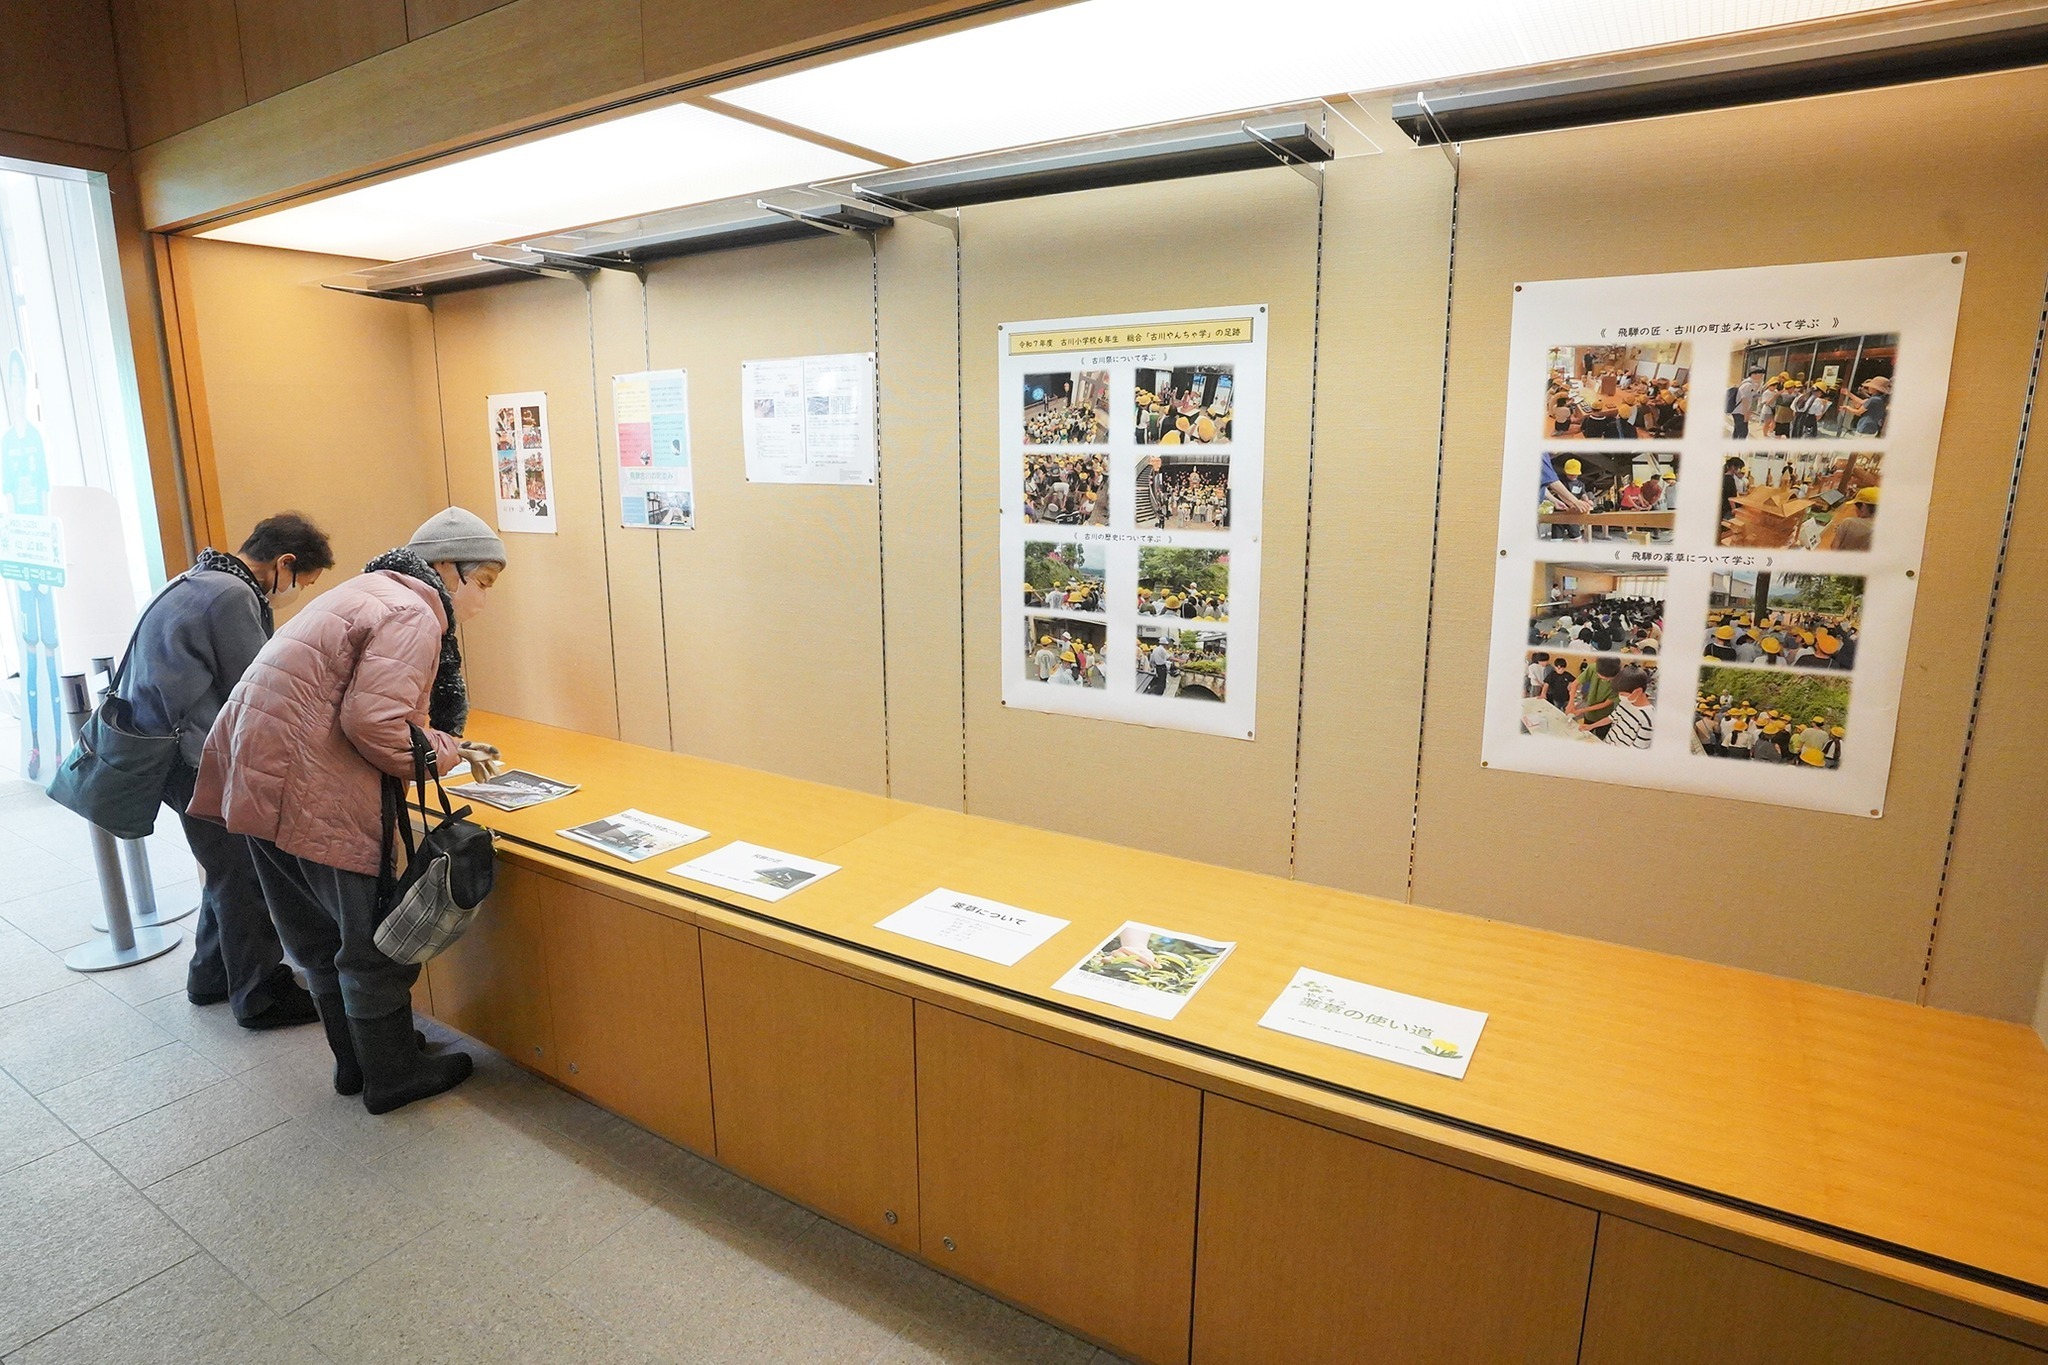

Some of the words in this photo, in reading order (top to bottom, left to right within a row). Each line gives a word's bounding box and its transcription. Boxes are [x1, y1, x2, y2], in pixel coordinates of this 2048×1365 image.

[1018, 338, 1053, 348] 令和7年度
[1060, 335, 1119, 346] 古川小学校6年生
[1631, 551, 1755, 566] 飛騨の薬草について学ぶ
[950, 901, 1026, 926] 薬草について
[1297, 995, 1435, 1039] 薬草の使い道
